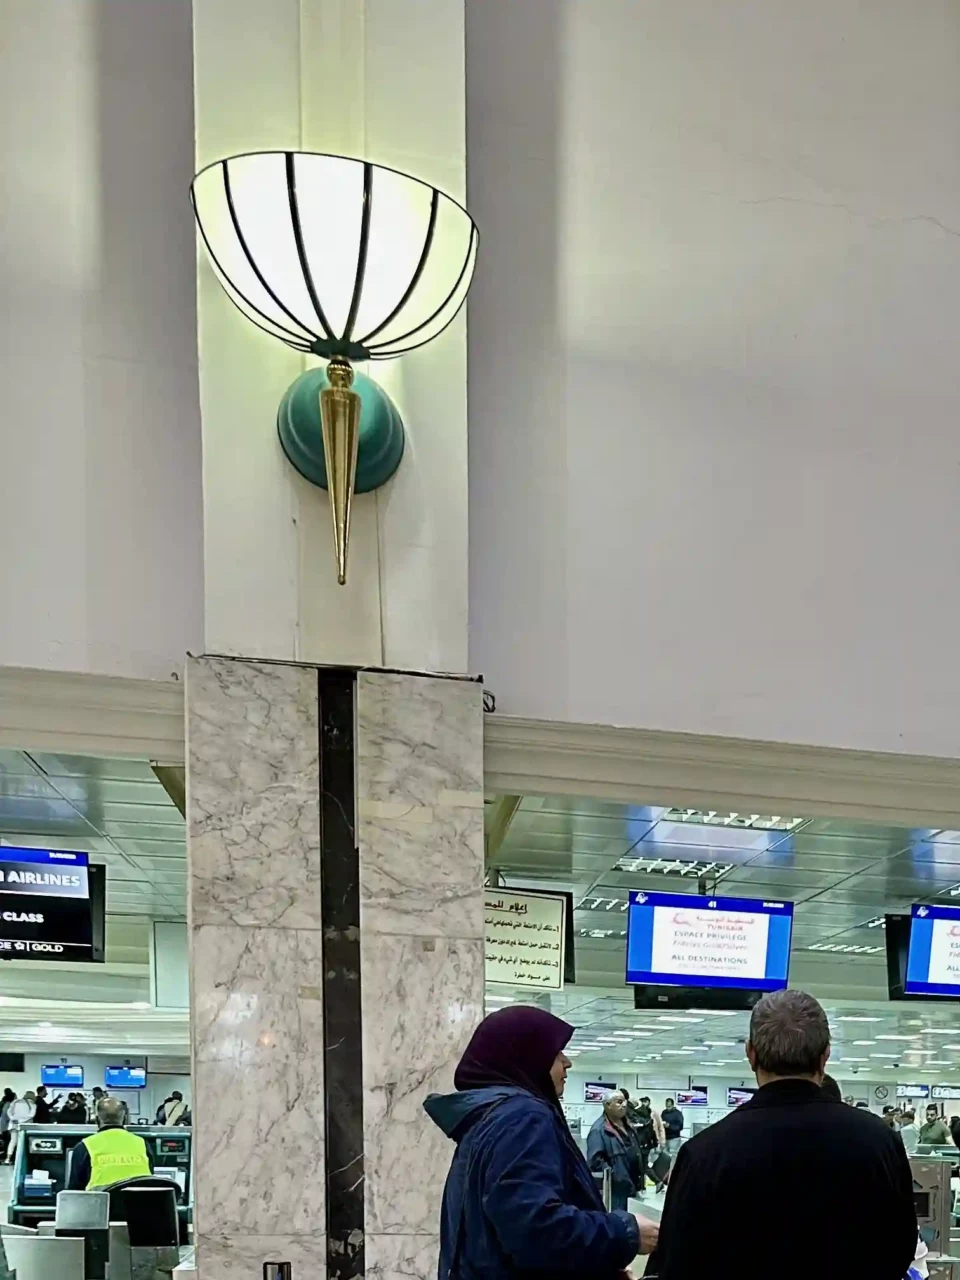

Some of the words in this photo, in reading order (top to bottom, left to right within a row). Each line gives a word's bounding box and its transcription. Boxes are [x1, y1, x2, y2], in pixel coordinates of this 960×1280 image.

[8, 870, 81, 887] AIRLINES
[708, 900, 717, 908] 41
[2, 911, 44, 923] CLASS
[707, 932, 748, 941] PRIVILEGE
[31, 943, 64, 952] GOLD
[688, 955, 748, 964] DESTINATIONS
